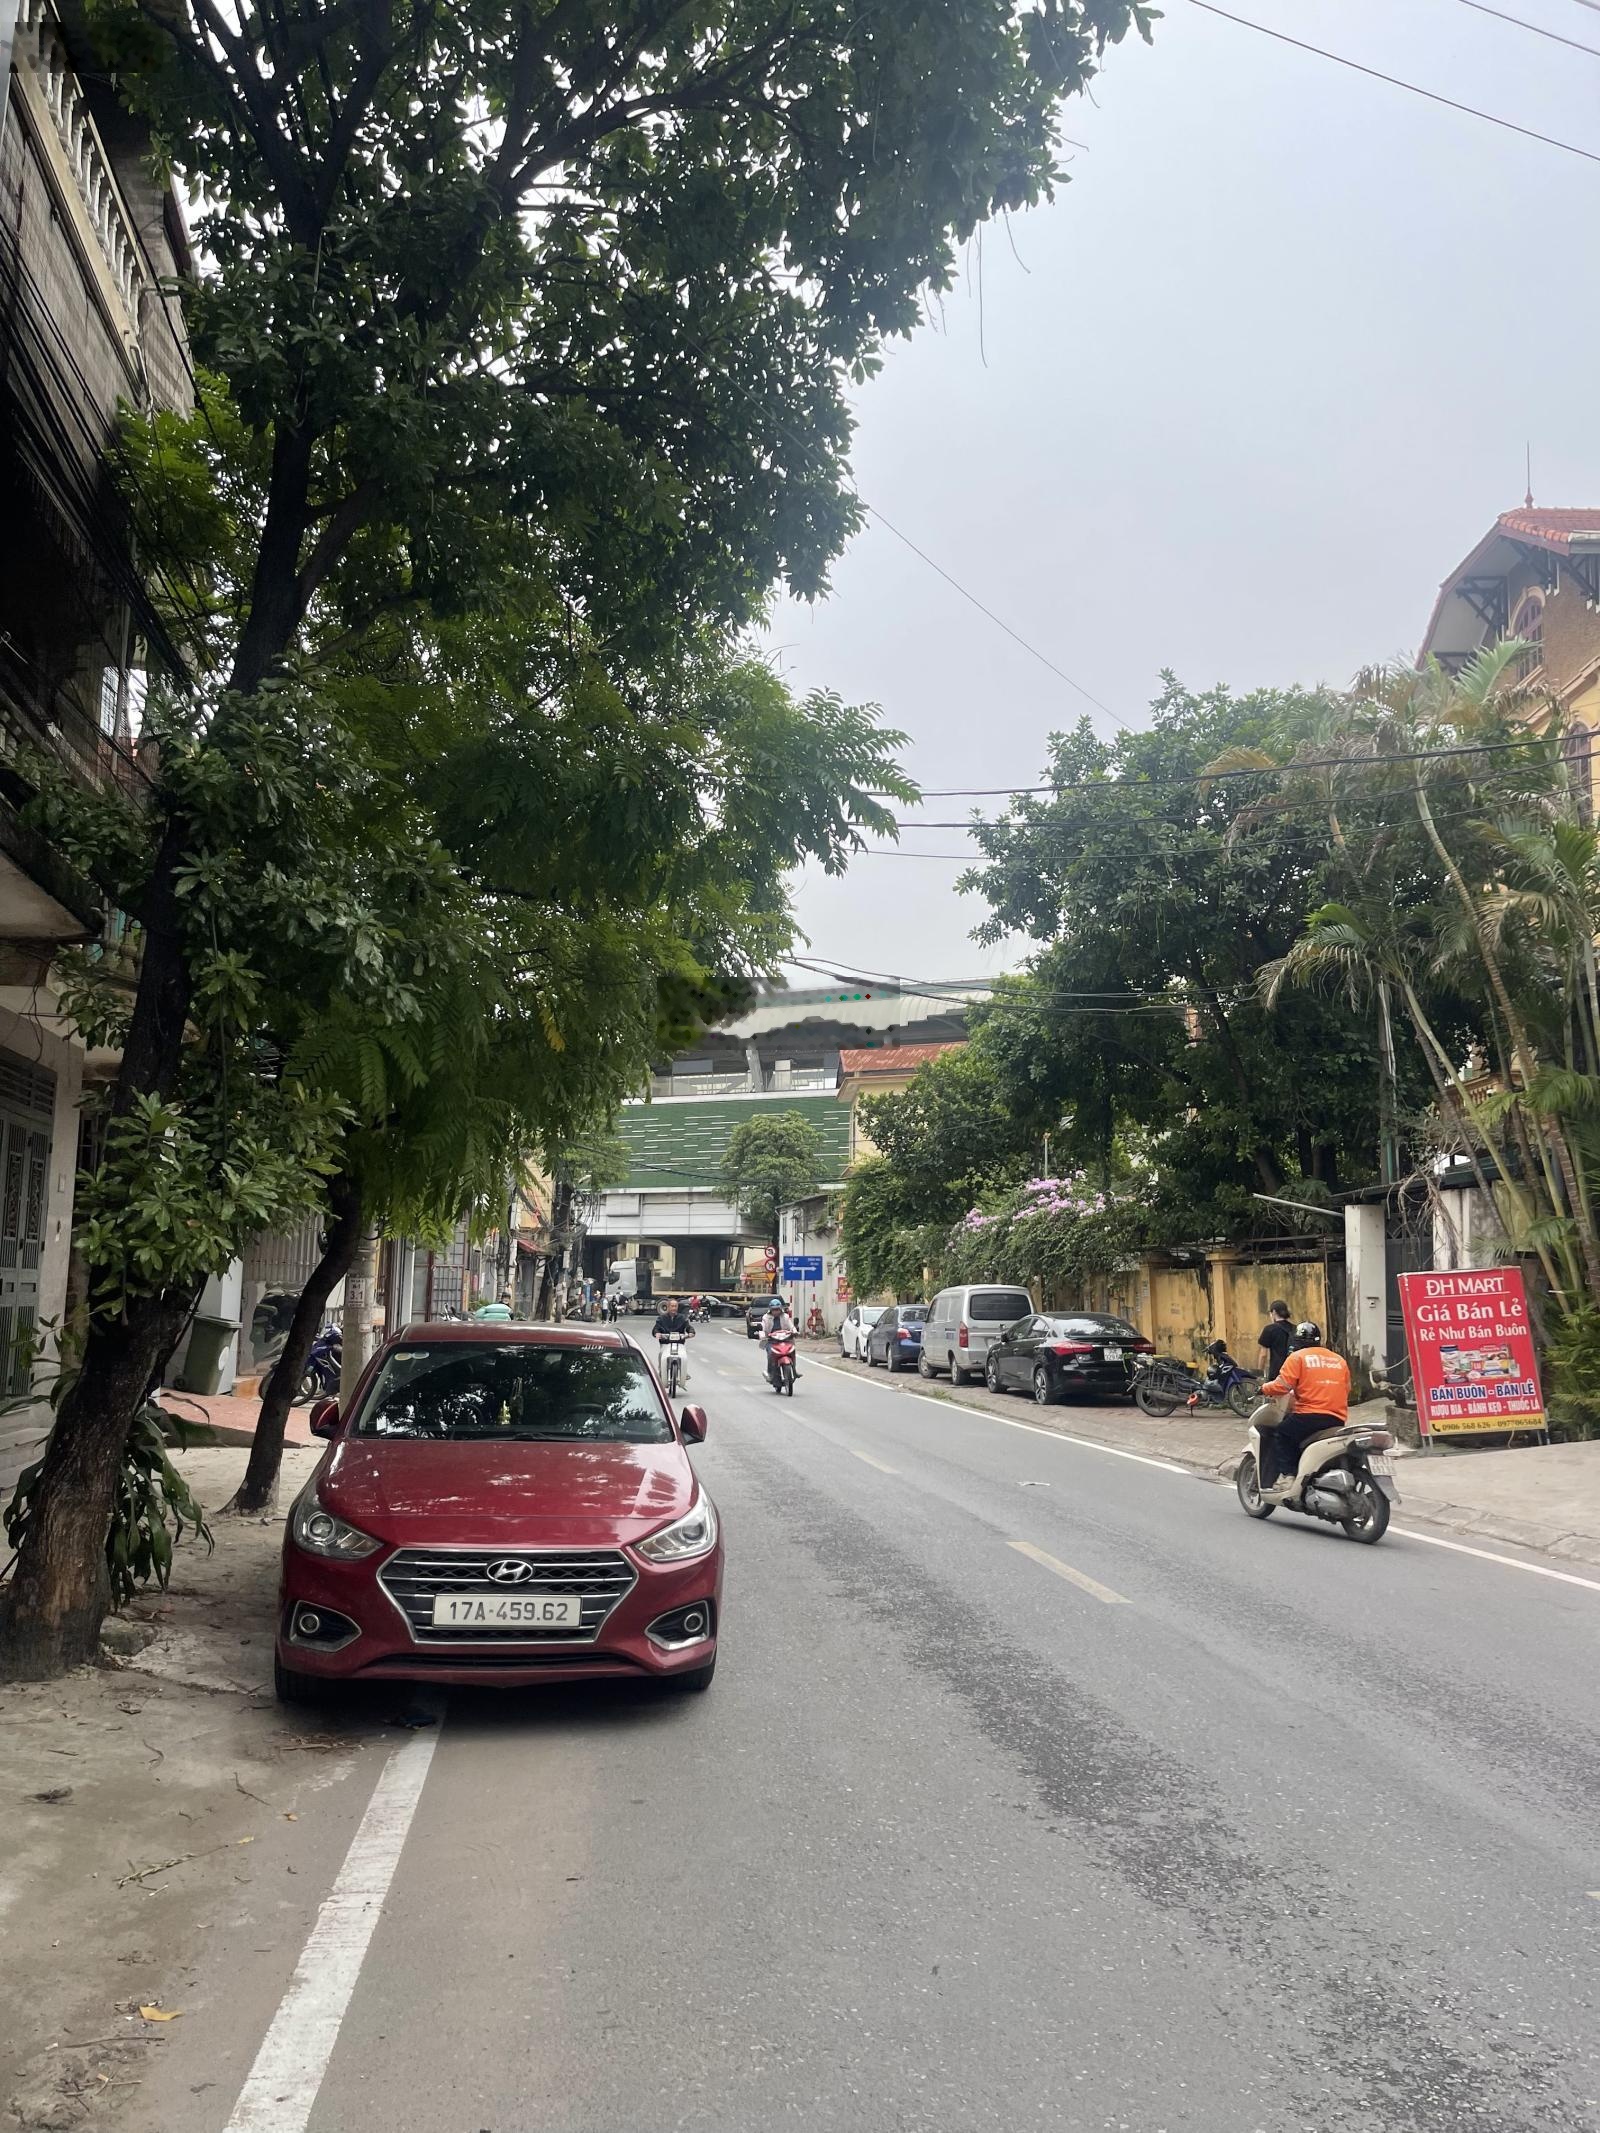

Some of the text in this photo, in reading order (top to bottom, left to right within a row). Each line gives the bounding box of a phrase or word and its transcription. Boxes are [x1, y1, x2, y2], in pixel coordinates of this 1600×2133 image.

[1426, 1277, 1504, 1296] ĐH MART
[1416, 1297, 1522, 1322] Giá Bán Lẻ
[1420, 1322, 1527, 1341] Rẻ Như Bán Buôn
[1431, 1385, 1454, 1401] BÁN
[1456, 1383, 1487, 1399] BUÔN
[1496, 1381, 1519, 1397] BÁN
[1521, 1379, 1535, 1395] LẺ
[450, 1601, 569, 1622] 17A-459.62
